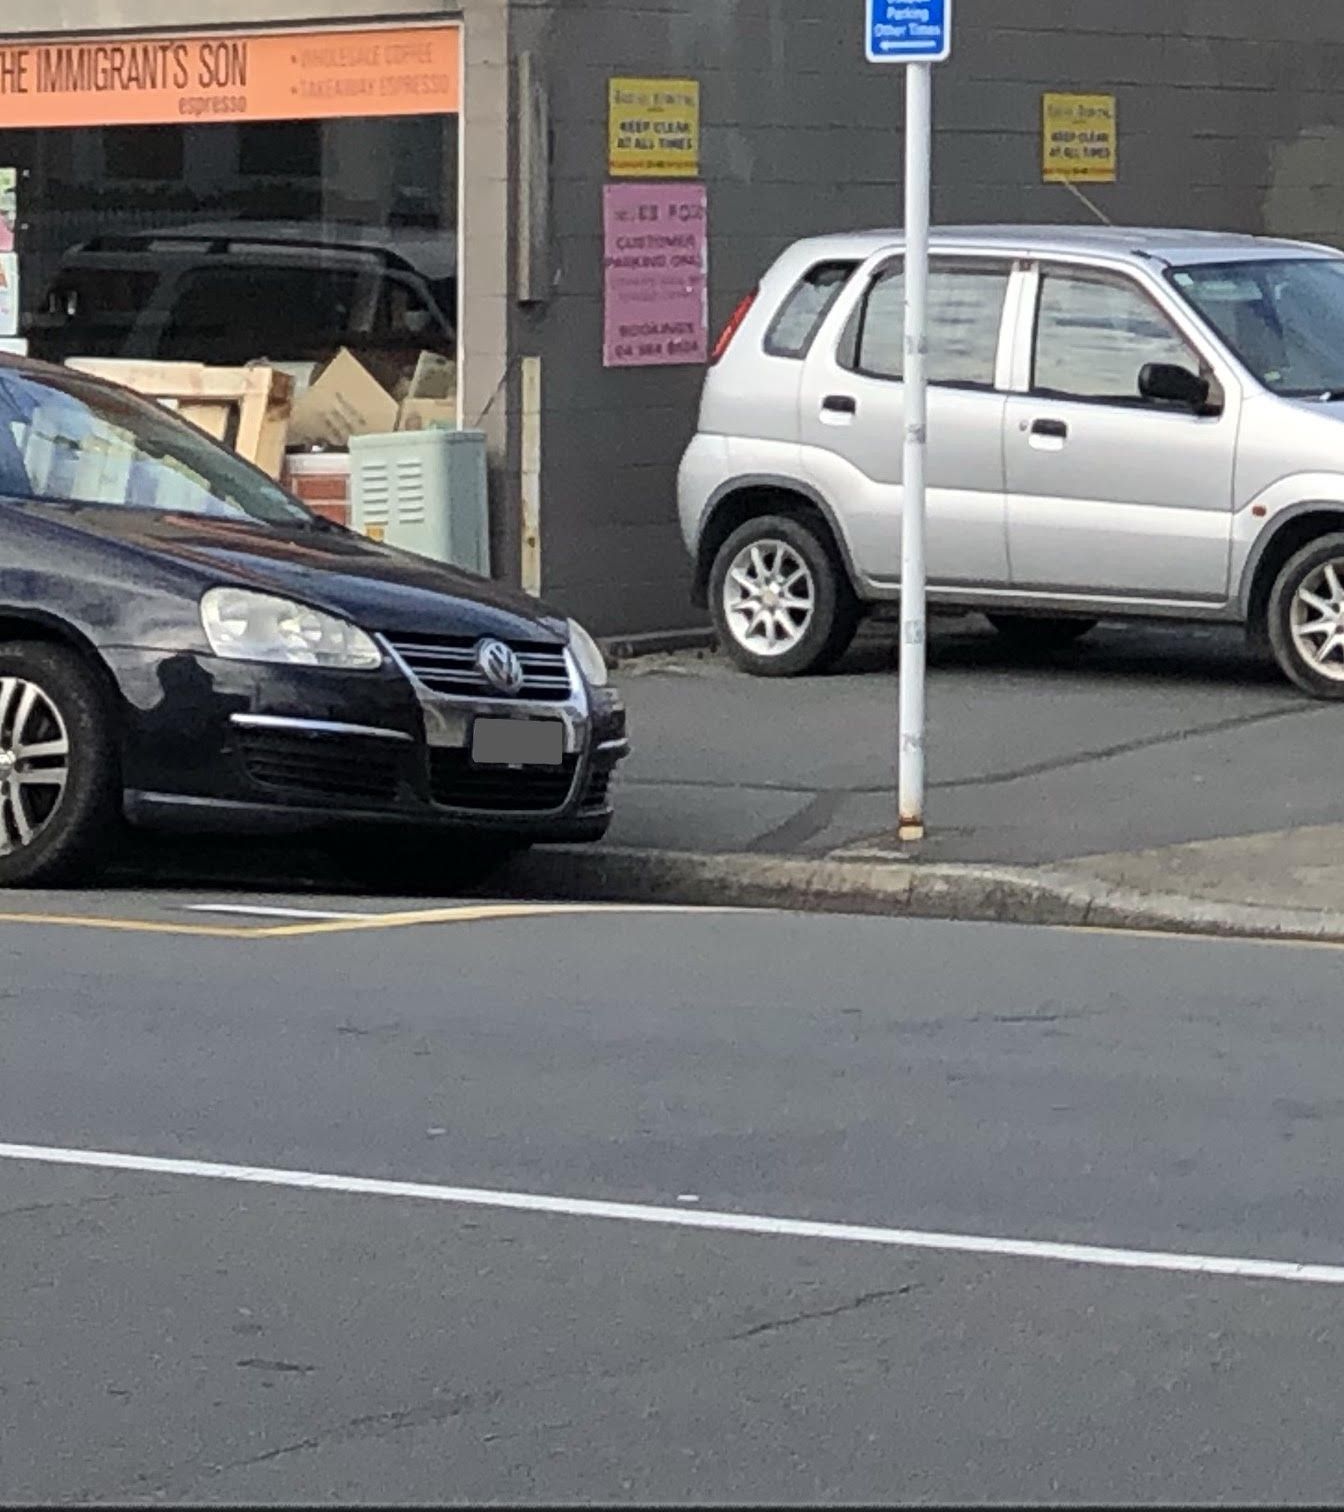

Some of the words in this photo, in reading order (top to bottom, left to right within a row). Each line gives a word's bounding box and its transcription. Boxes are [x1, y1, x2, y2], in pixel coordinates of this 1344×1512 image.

[886, 6, 929, 22] Parking
[874, 23, 907, 37] Other
[0, 50, 29, 94] HE
[199, 41, 248, 88] SON
[178, 94, 247, 116] espresso
[620, 121, 650, 133] KEEP
[653, 121, 689, 134] CLEAR
[616, 235, 696, 250] CUSTOMER
